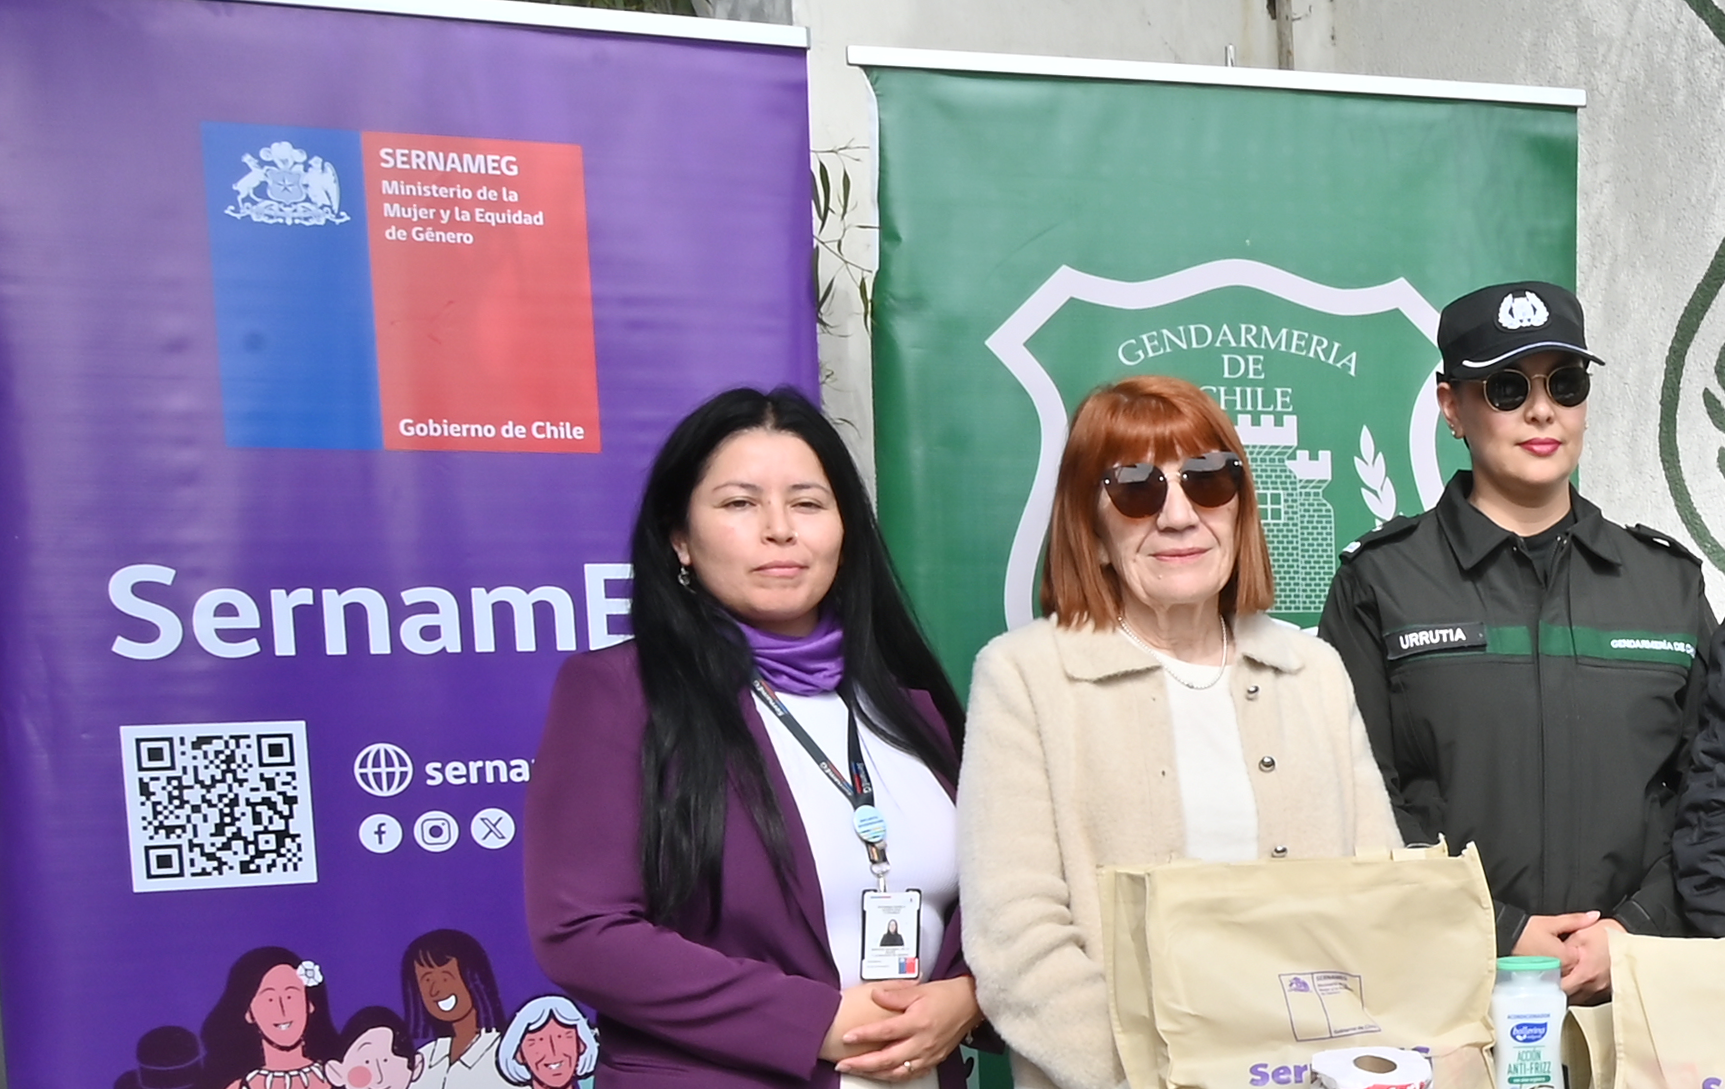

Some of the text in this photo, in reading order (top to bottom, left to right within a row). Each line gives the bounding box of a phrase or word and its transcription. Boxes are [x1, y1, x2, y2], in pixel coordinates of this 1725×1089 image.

[379, 147, 519, 177] SERNAMEG
[381, 179, 519, 203] Ministerio de la
[383, 202, 545, 227] Mujer y la Equidad
[384, 225, 474, 245] de Género
[1116, 323, 1358, 377] GENDARMERIA
[1222, 354, 1265, 380] DE
[399, 418, 585, 440] Gobierno de Chile
[108, 562, 634, 660] SernamE
[1399, 627, 1467, 650] URRUTIA
[424, 754, 534, 787] serna
[1507, 1061, 1552, 1075] ANTI-FRIZZ
